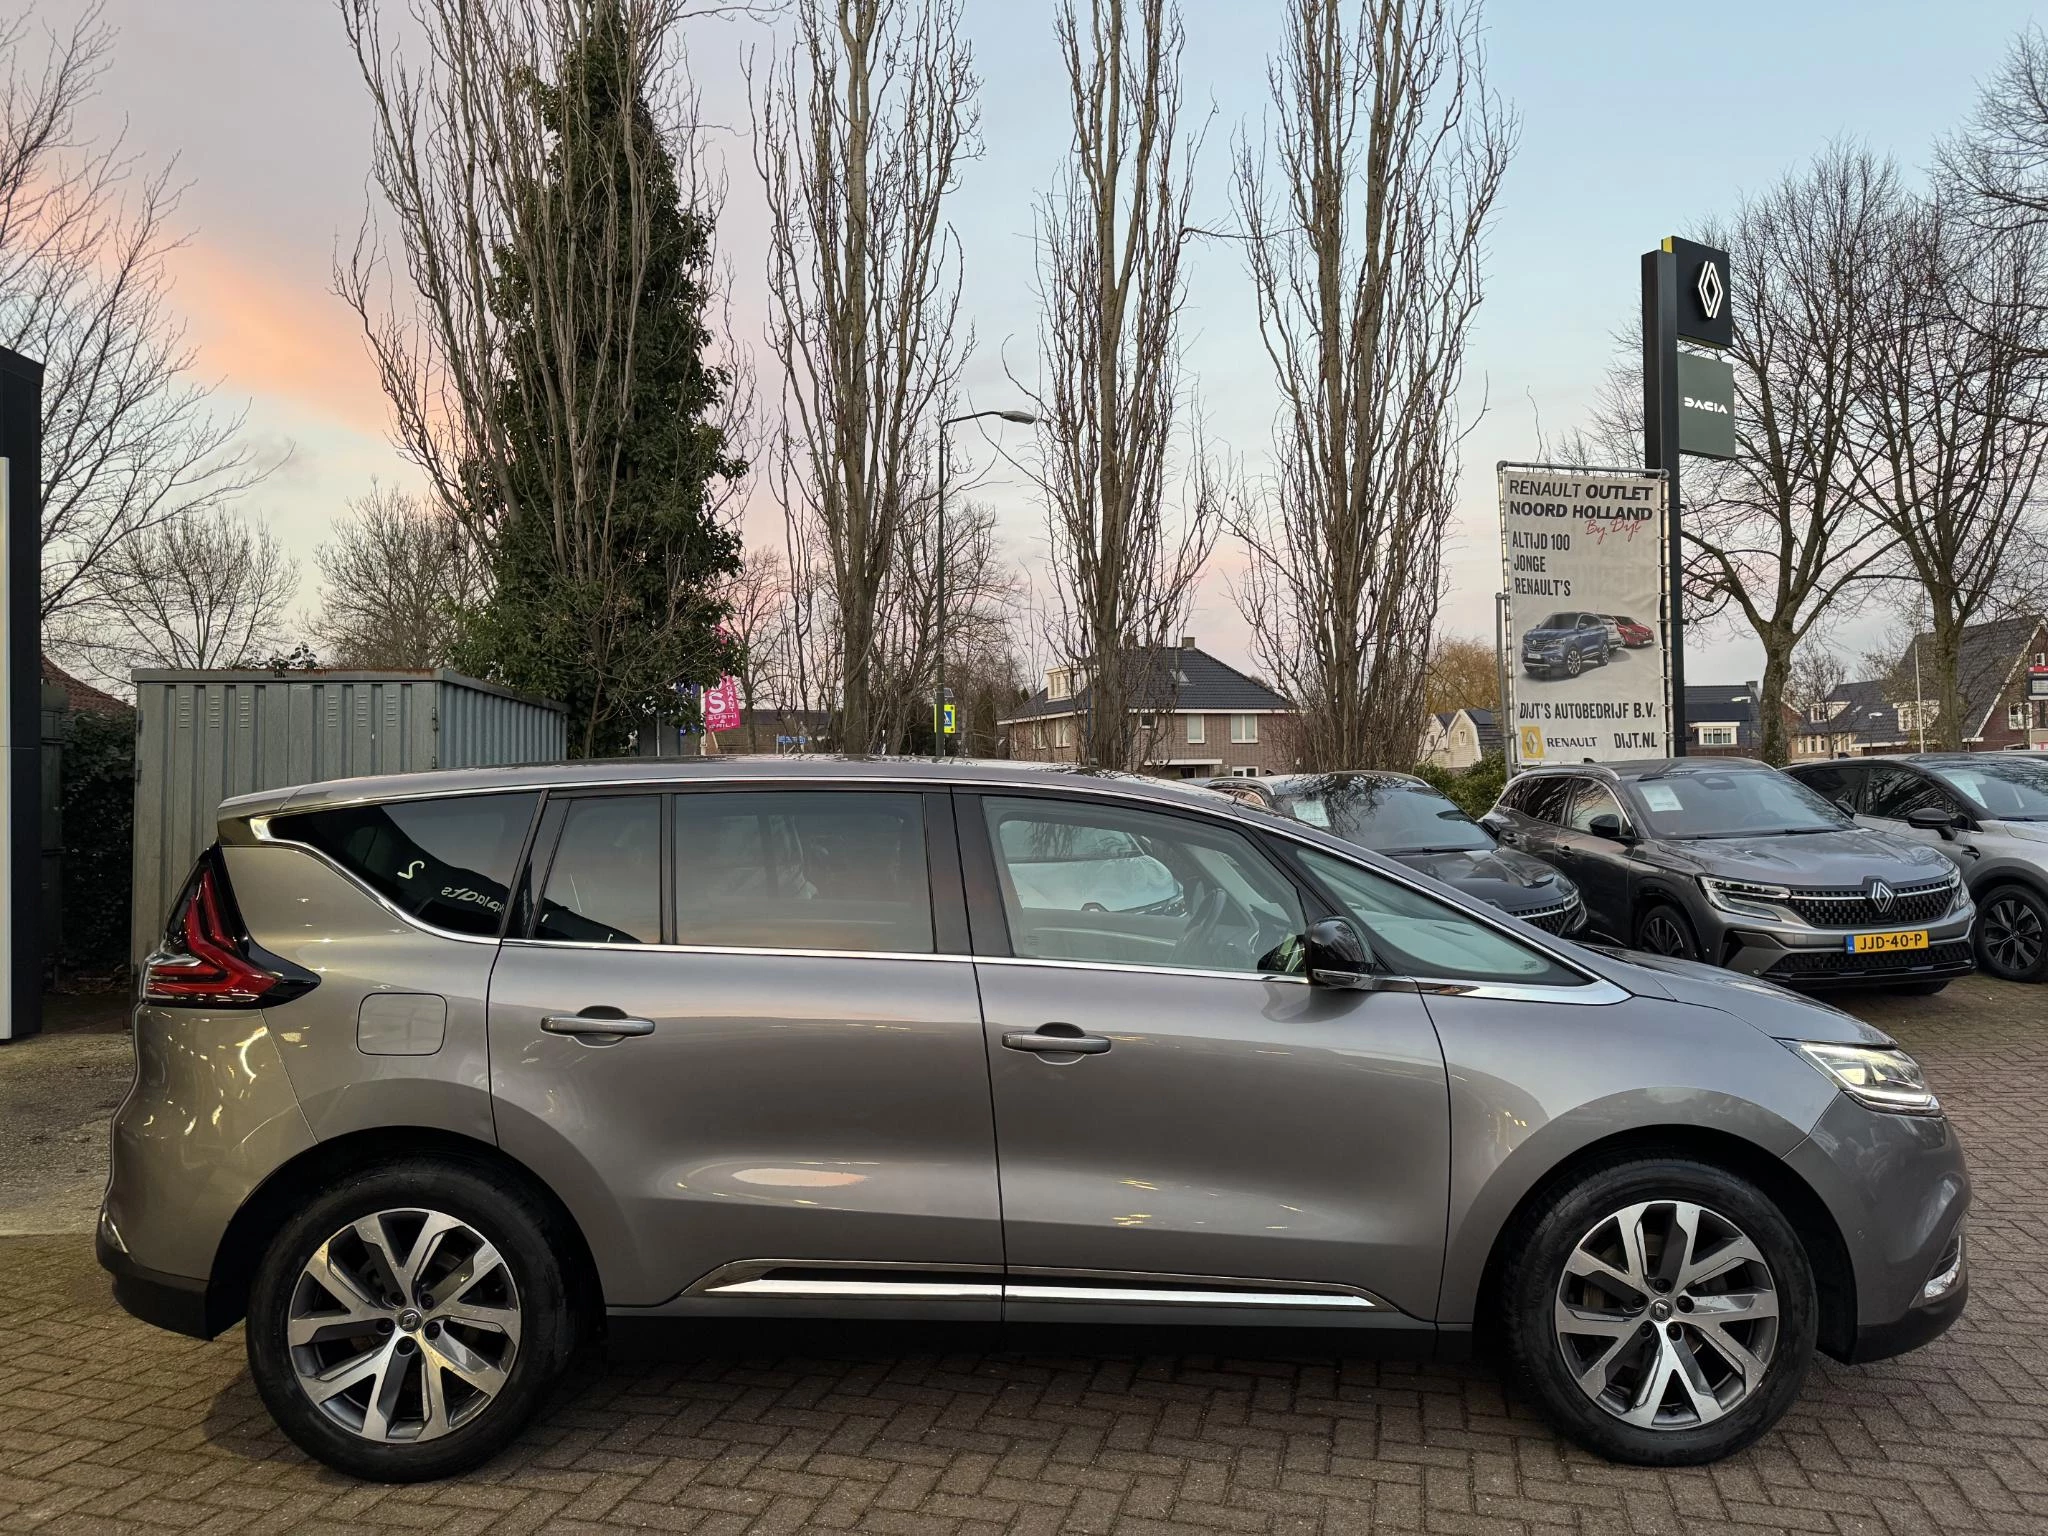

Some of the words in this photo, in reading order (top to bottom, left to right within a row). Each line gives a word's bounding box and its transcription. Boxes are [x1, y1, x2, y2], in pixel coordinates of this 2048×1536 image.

[1684, 397, 1728, 414] DACIA
[1509, 480, 1581, 498] RENAULT
[1585, 484, 1654, 501] OUTLET
[1509, 501, 1568, 518] NOORD
[1572, 505, 1653, 521] HOLLAND
[1512, 531, 1548, 549] ALTIJD
[1551, 533, 1570, 551] 100
[1514, 555, 1546, 573] JONGE
[1515, 577, 1571, 597] RENAULT'S
[1519, 702, 1551, 719] DIJT'S
[1555, 702, 1629, 719] AUTOBEDRIJF
[1633, 702, 1657, 719] B.V.
[1546, 736, 1598, 748] RENAULT
[1613, 732, 1658, 749] DIJT.NL
[1860, 933, 1922, 950] JJD-40-P
